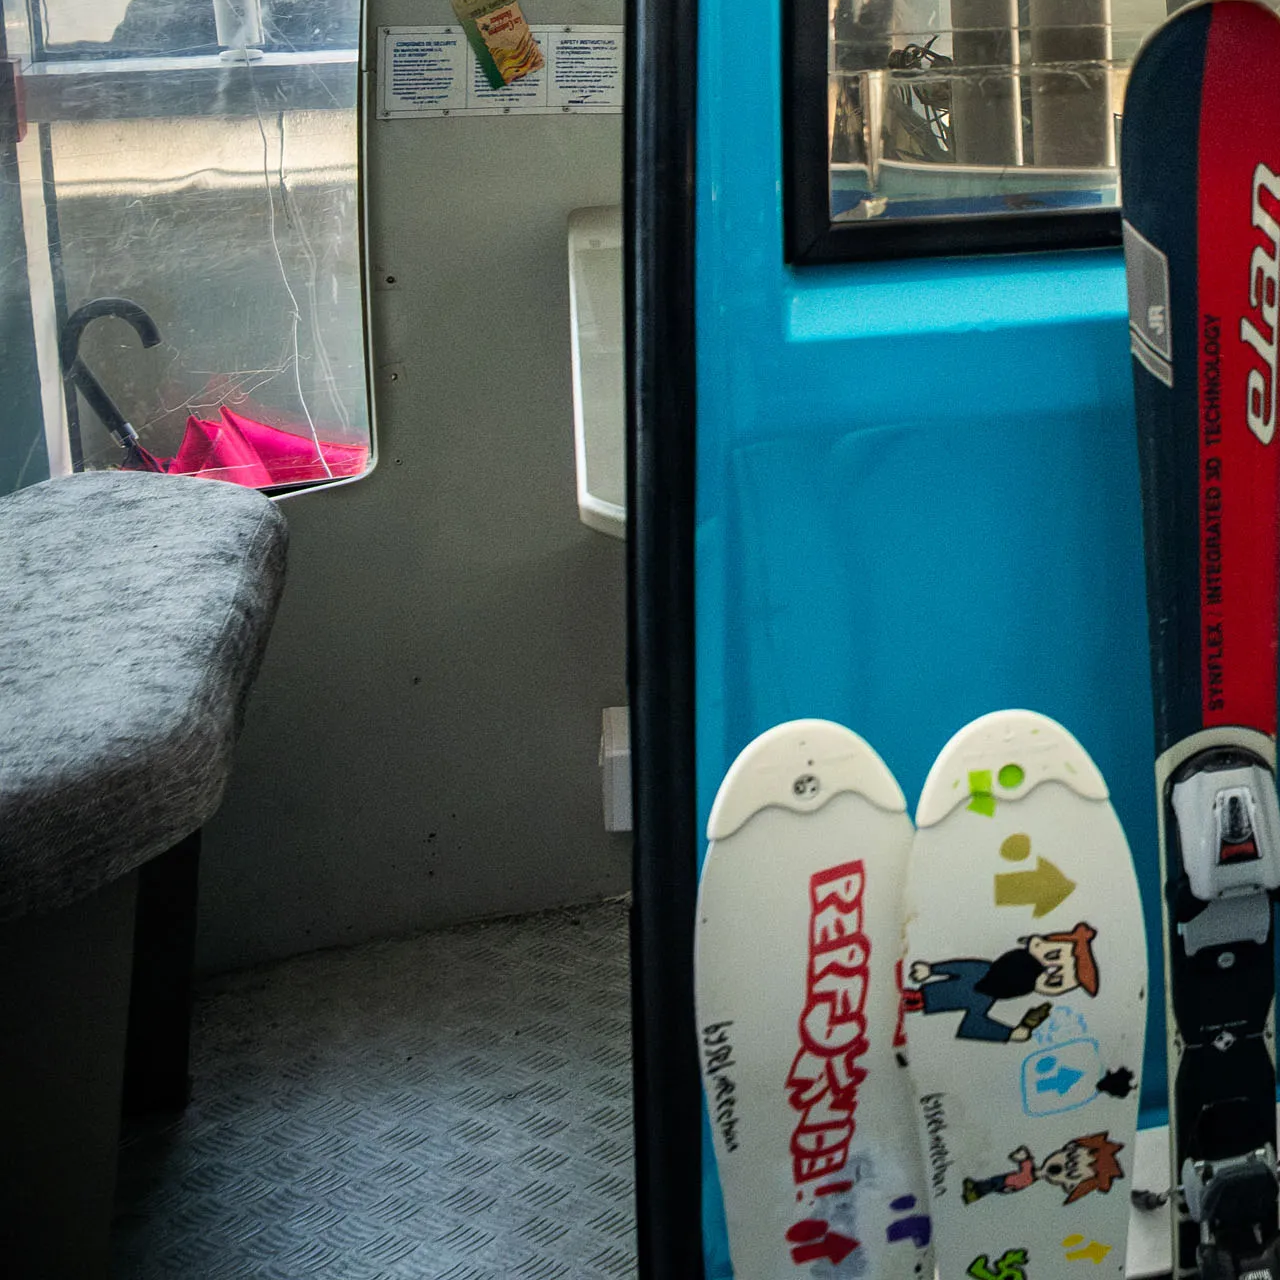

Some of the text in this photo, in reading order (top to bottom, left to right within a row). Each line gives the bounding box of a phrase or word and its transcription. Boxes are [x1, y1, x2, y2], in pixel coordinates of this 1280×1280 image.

[1148, 305, 1165, 336] JR
[1203, 313, 1222, 447] TECHNOLOGY
[1205, 458, 1221, 482] 3D
[1204, 487, 1222, 604] INTEGRATED
[1206, 623, 1224, 712] SYNFLEX
